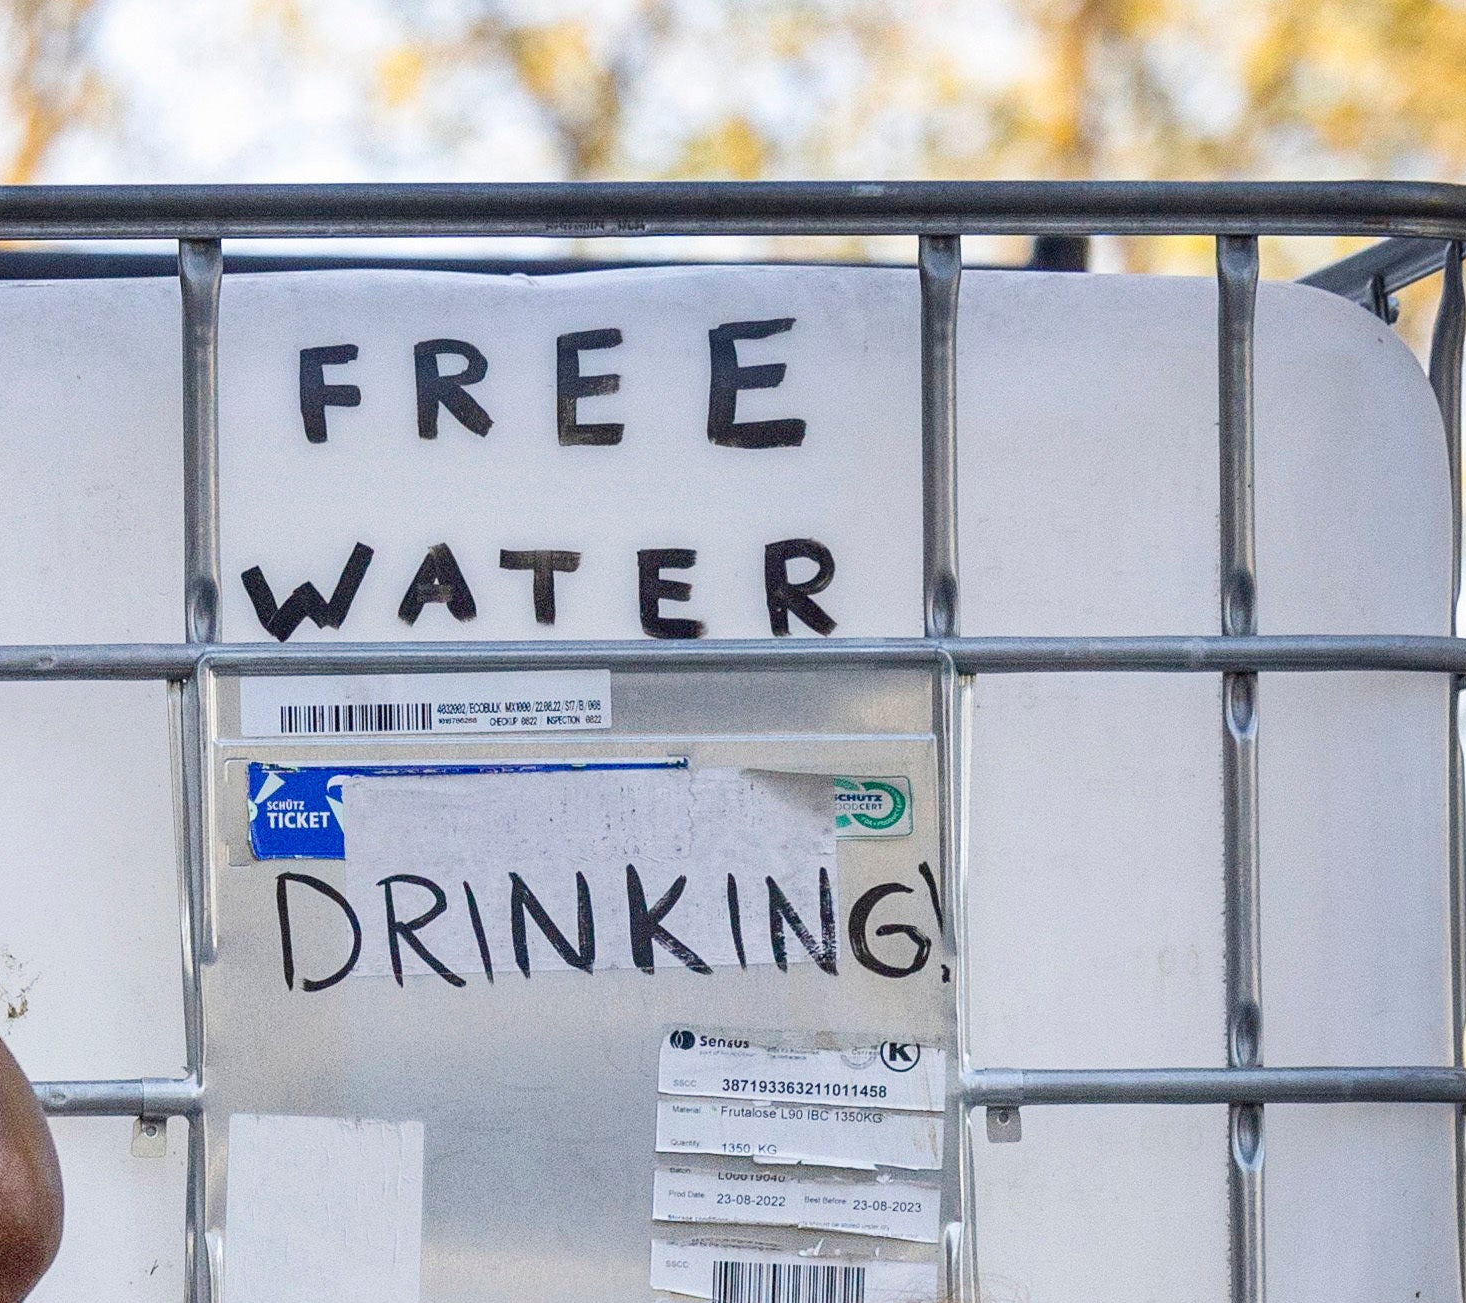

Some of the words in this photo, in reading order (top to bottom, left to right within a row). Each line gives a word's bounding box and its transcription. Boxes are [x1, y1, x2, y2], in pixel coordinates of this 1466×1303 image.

[298, 317, 808, 449] FREE
[240, 538, 839, 641] WATER
[546, 714, 581, 726] INSPECTION
[266, 799, 305, 811] SCHÜTZ
[266, 811, 331, 830] TICKET
[275, 860, 951, 993] DRINKING!
[673, 1078, 697, 1088] SSCC
[721, 1078, 888, 1099] 387193363211011458
[672, 1105, 701, 1115] Material
[721, 1106, 777, 1120] Frutalose
[780, 1108, 803, 1121] L90
[807, 1109, 830, 1122] IBC
[834, 1111, 883, 1124] 1350KG
[670, 1139, 701, 1149] Quantity
[721, 1142, 751, 1155] 1350
[758, 1143, 778, 1155] KG
[688, 1191, 705, 1199] Date
[717, 1193, 786, 1207] 23-08-2022
[852, 1198, 923, 1213] 23-08-2023
